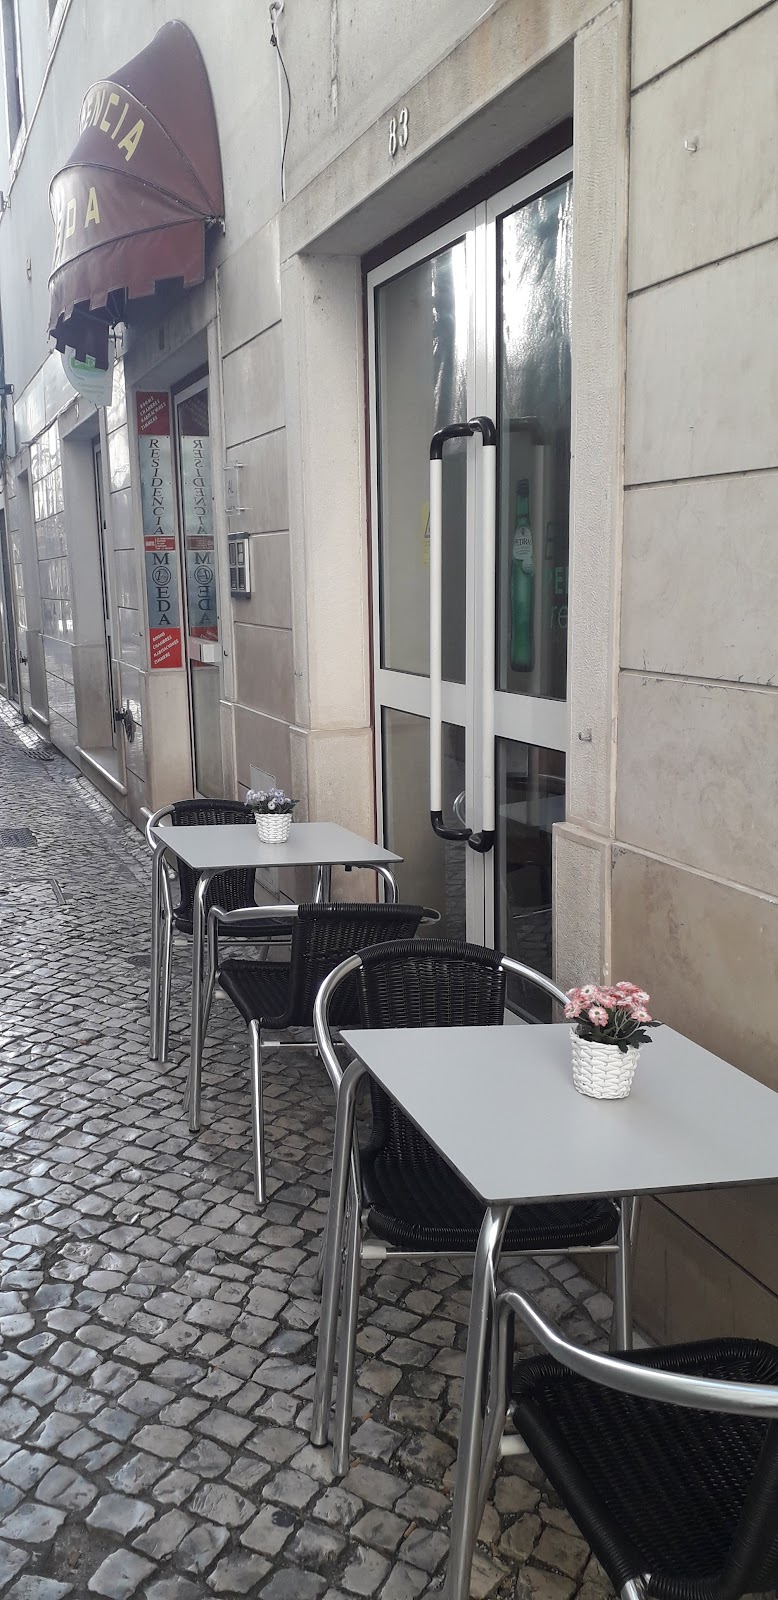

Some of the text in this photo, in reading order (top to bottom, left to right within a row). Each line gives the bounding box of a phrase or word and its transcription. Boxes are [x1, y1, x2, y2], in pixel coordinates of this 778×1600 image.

[388, 106, 408, 156] 83
[148, 438, 164, 535] RESIDENCIA
[543, 566, 568, 595] PE
